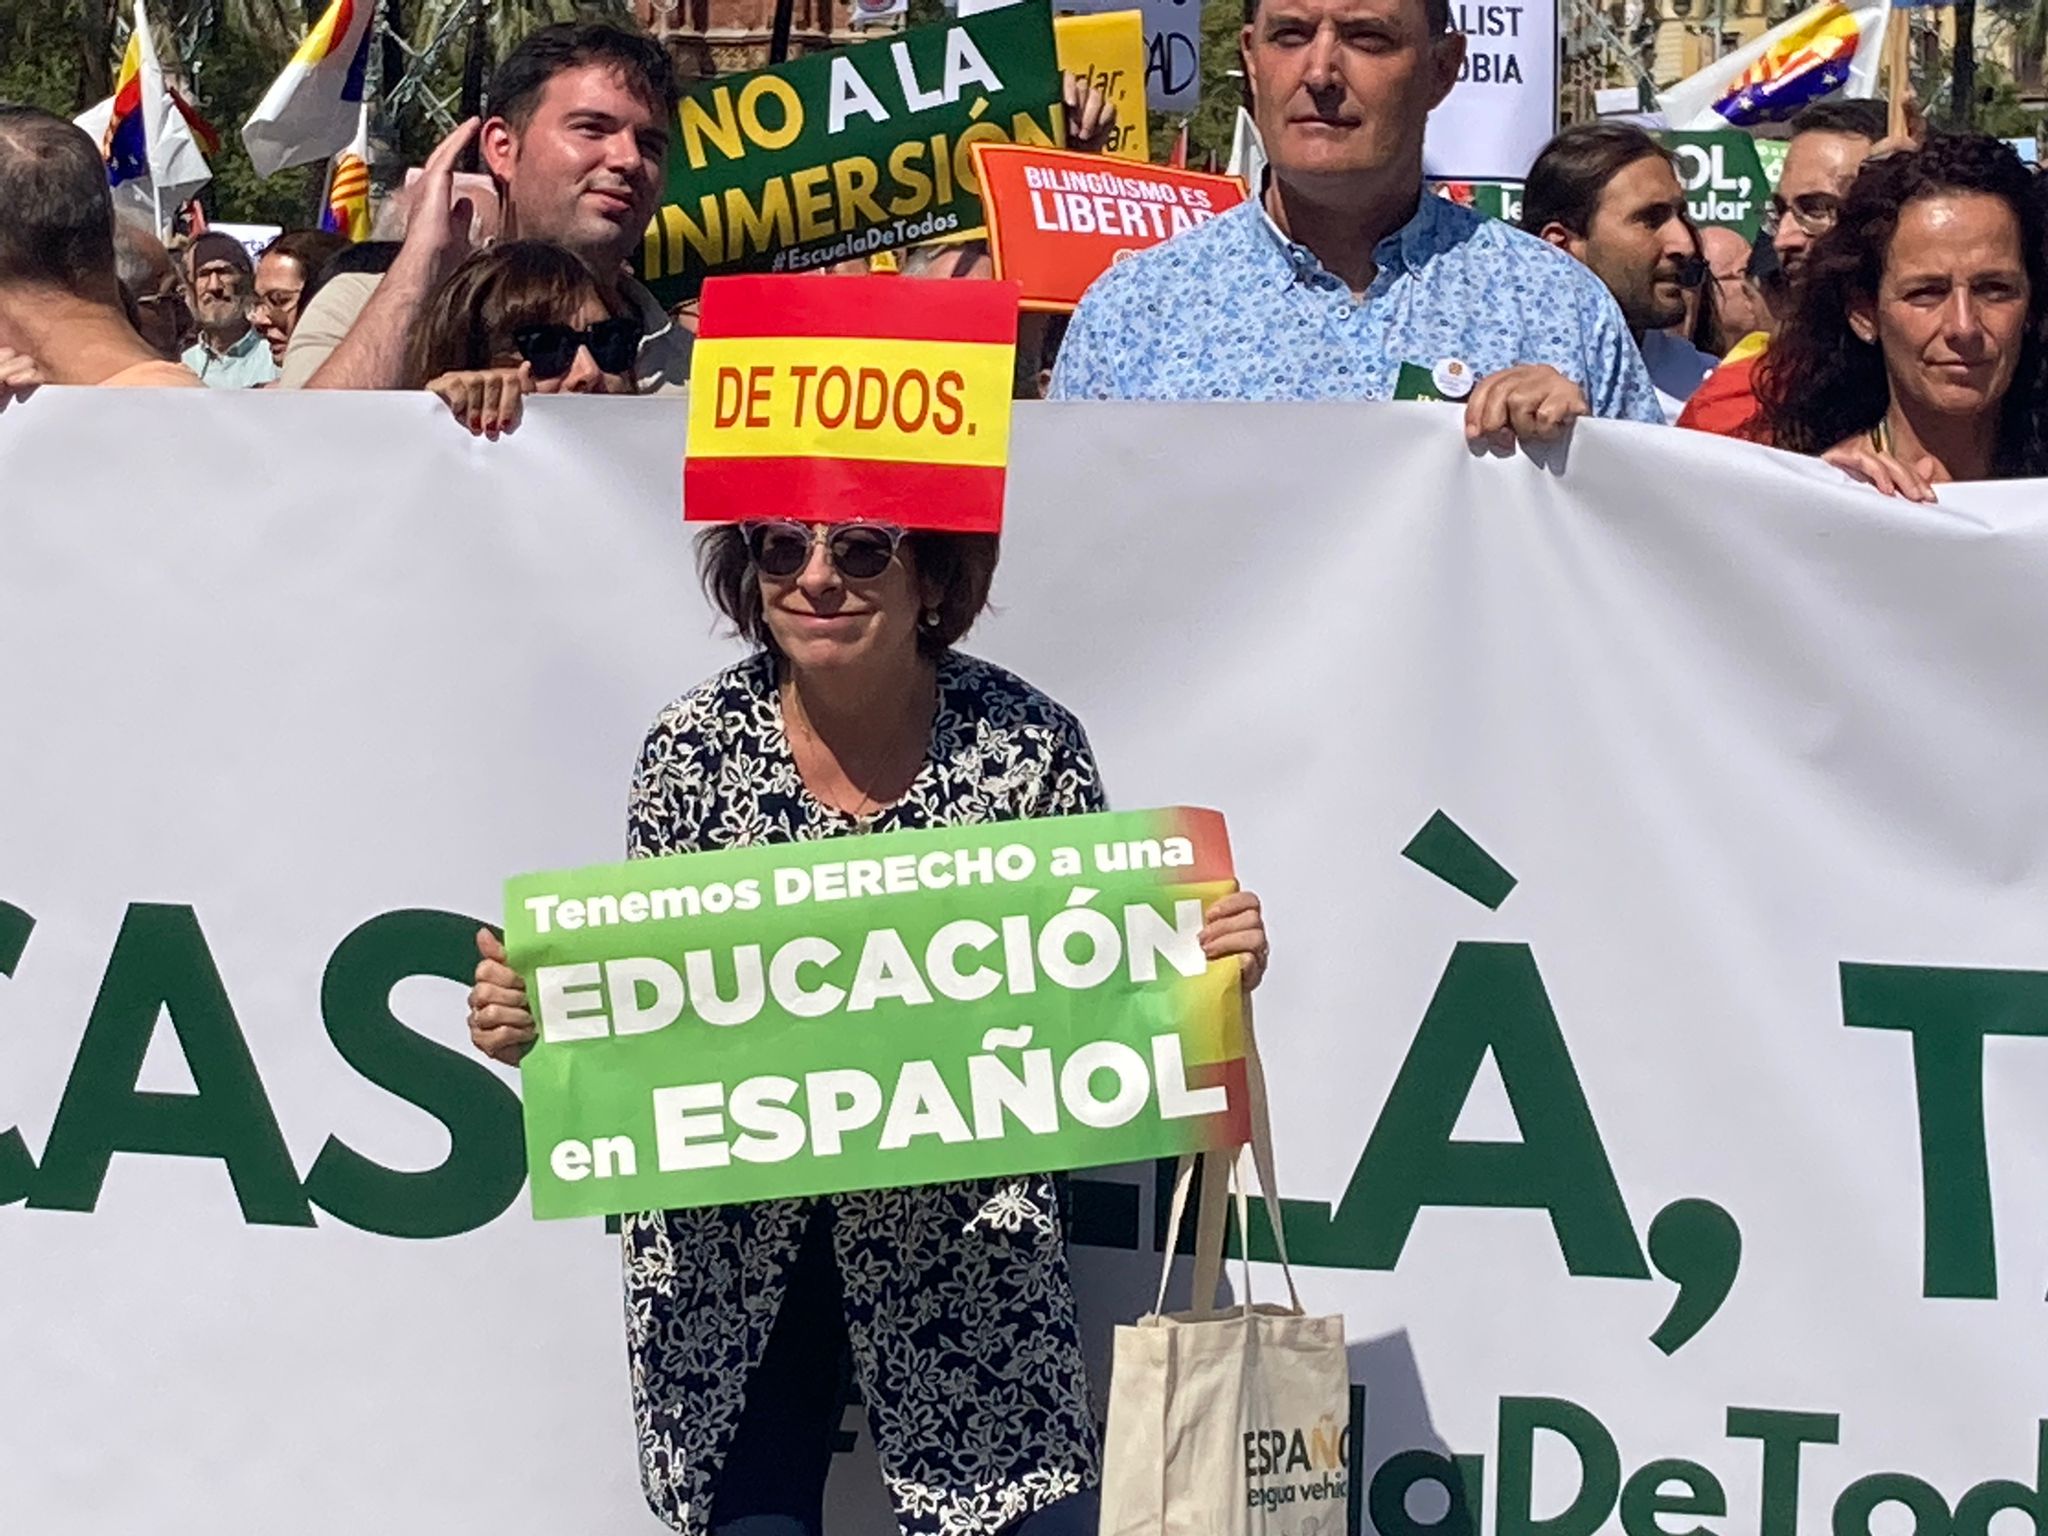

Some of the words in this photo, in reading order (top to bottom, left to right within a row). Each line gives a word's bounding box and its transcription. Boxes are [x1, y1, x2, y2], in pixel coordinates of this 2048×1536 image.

[678, 75, 804, 169] NO
[828, 56, 890, 134] A
[890, 26, 1004, 113] LA
[1023, 165, 1178, 201] BILINGÜISMO
[1179, 185, 1213, 209] ES
[772, 211, 959, 273] #EscuelaDeTodos
[714, 366, 775, 428] DE
[790, 365, 977, 436] TODOS.
[524, 878, 762, 934] Tenemos
[773, 843, 1037, 907] DERECHO
[1049, 845, 1082, 877] a
[1094, 835, 1195, 873] una
[535, 886, 1208, 1044] EDUCACIÓN
[550, 1134, 638, 1182] en
[652, 1024, 1229, 1173] ESPAÑOL
